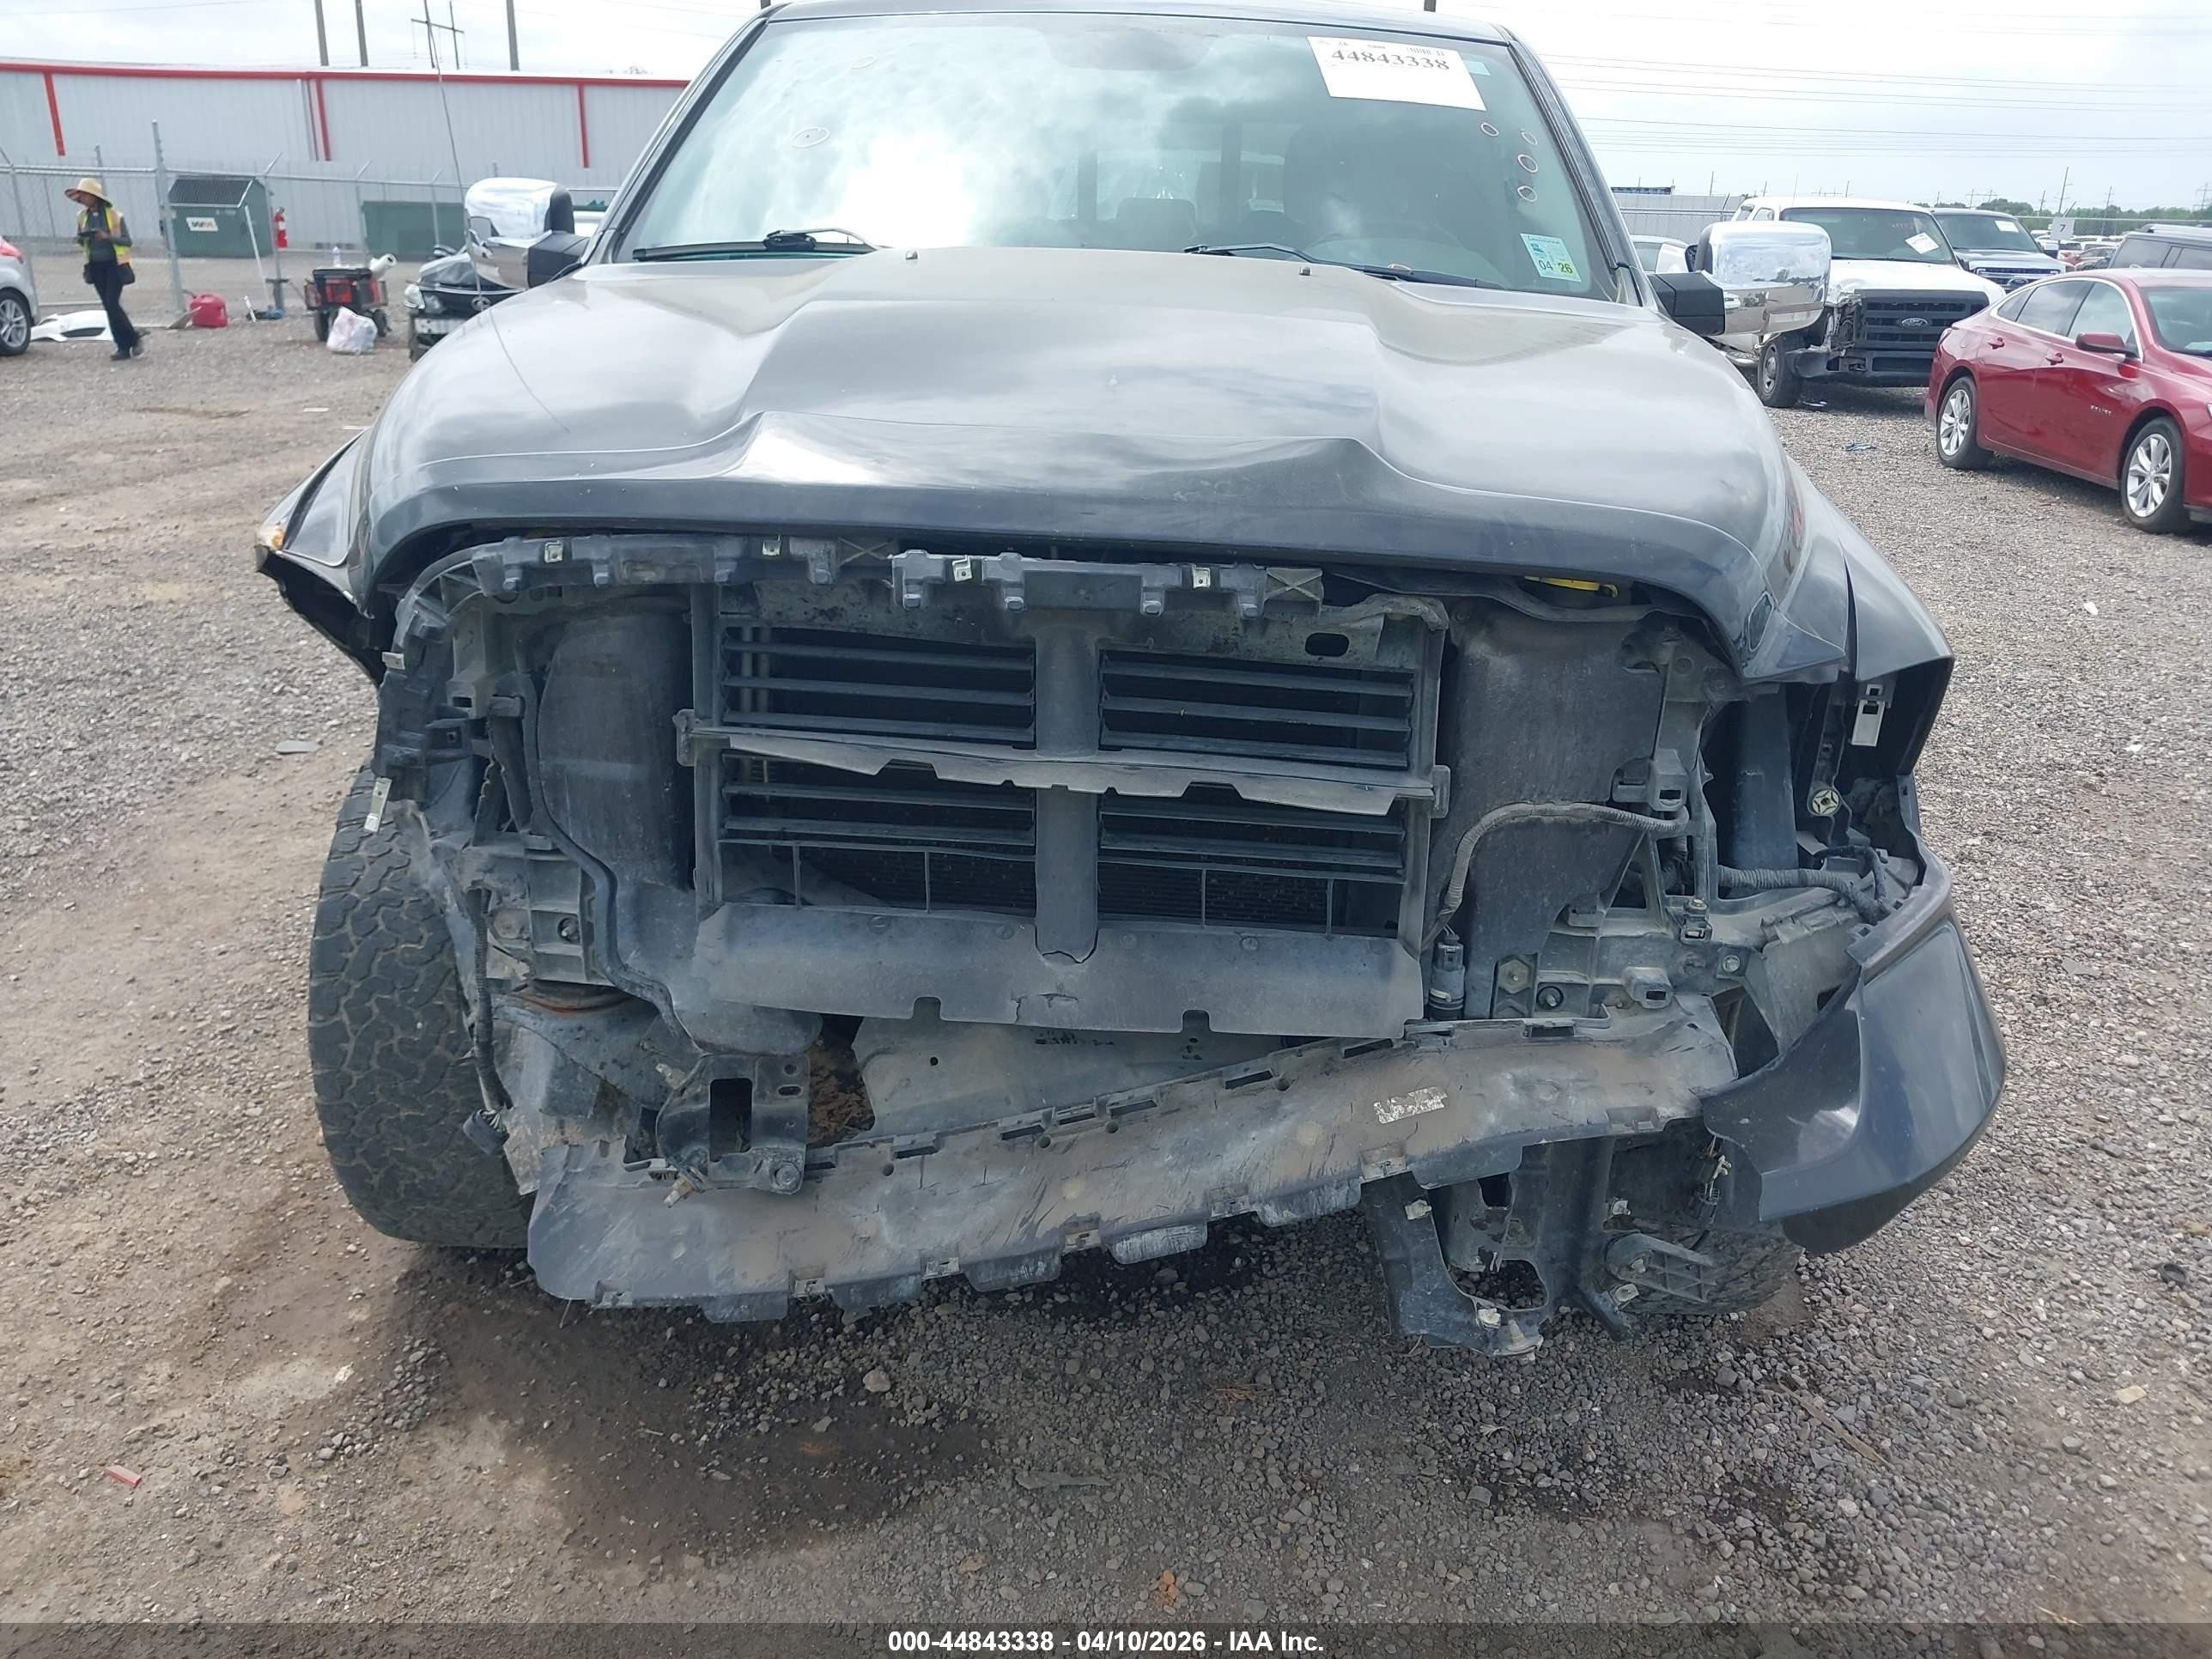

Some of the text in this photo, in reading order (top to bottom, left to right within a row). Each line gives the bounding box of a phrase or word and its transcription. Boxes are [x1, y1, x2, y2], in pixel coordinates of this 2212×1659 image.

[1331, 49, 1450, 70] 44843338
[2060, 224, 2066, 233] 7
[1538, 259, 1573, 274] 04 26
